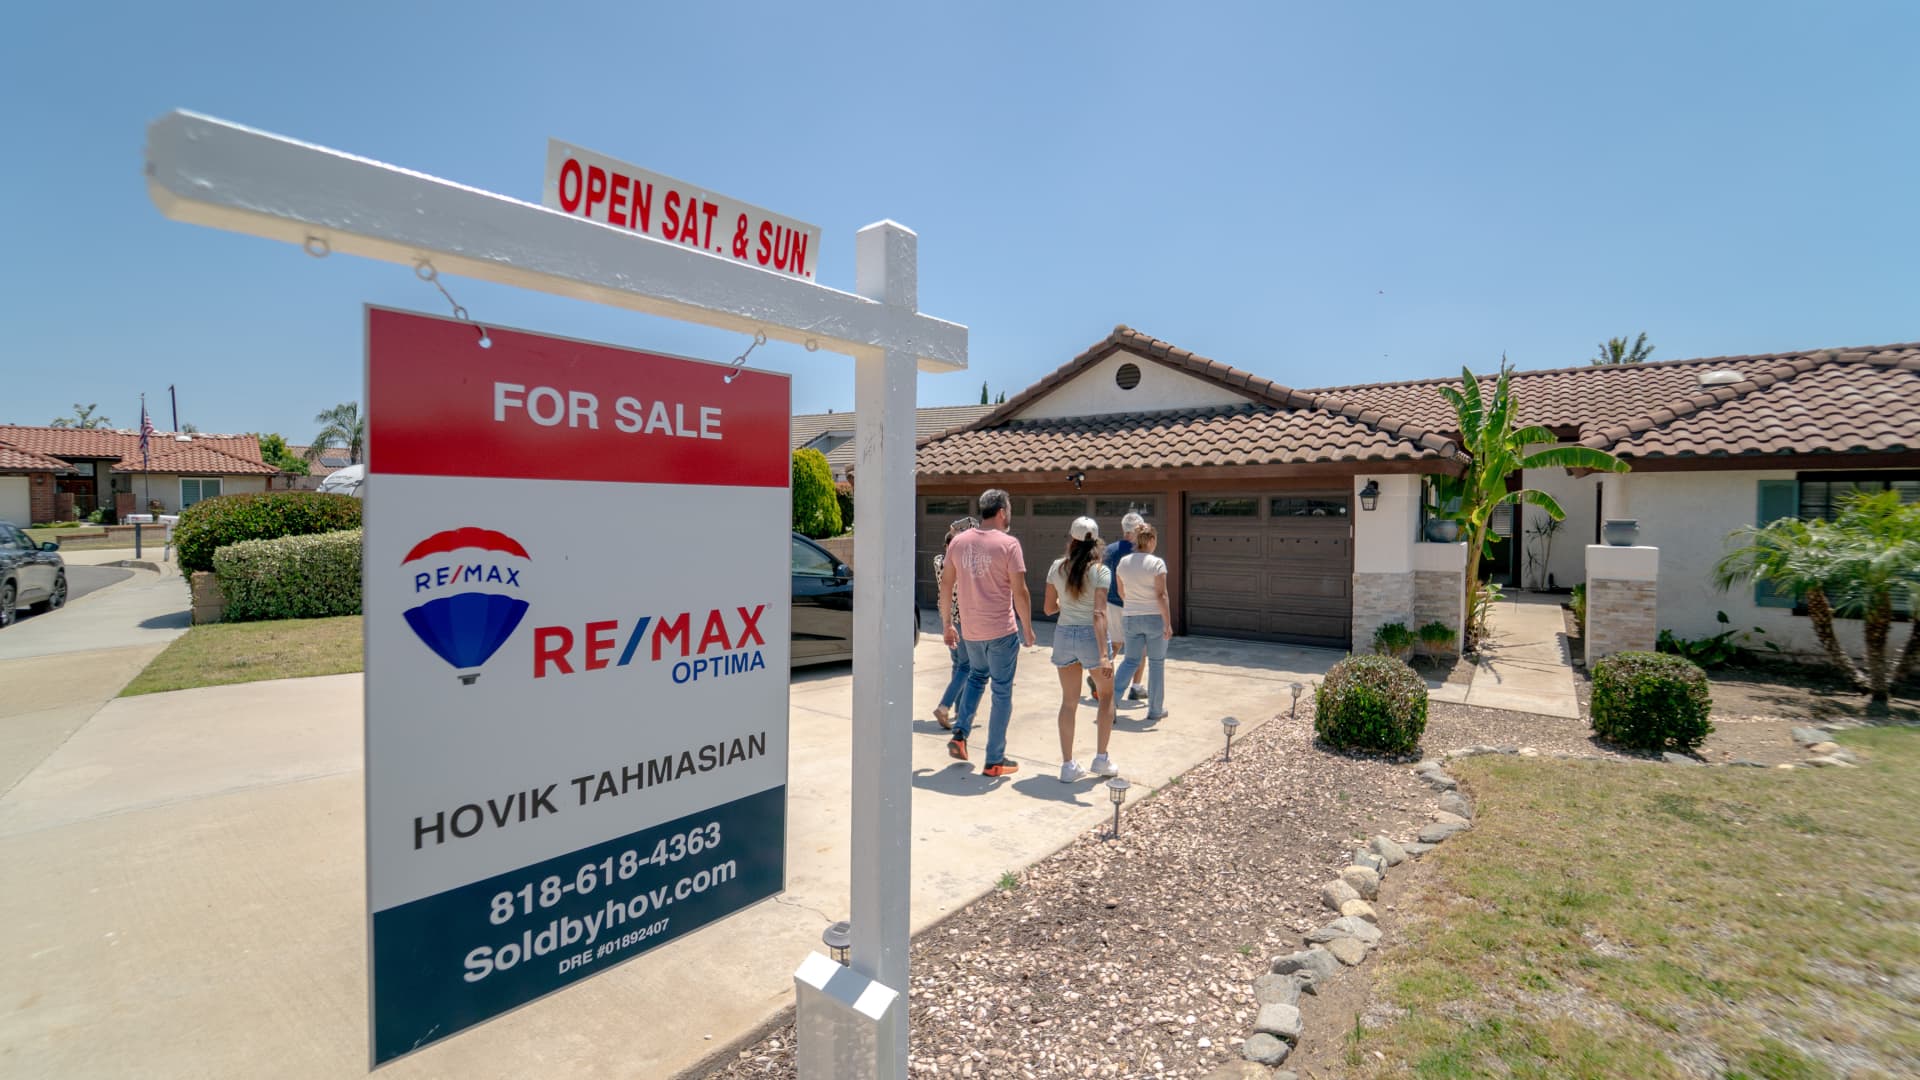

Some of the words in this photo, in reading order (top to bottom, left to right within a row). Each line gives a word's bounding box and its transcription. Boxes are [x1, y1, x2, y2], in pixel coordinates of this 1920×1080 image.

[559, 158, 653, 233] OPEN
[661, 190, 722, 253] SAT.
[732, 213, 750, 260] &
[756, 220, 811, 277] SUN.
[493, 381, 599, 430] FOR
[614, 396, 723, 440] SALE
[415, 564, 521, 593] RE/MAX
[533, 604, 767, 678] RE/MAX
[671, 650, 766, 684] OPTIMA
[413, 783, 559, 850] HOVIK
[571, 731, 767, 806] TAHMASIAN
[489, 821, 721, 926] 818-618-4363
[463, 858, 737, 983] Soldbyhov.com
[559, 949, 593, 975] DRE
[597, 918, 670, 959] #01892407
